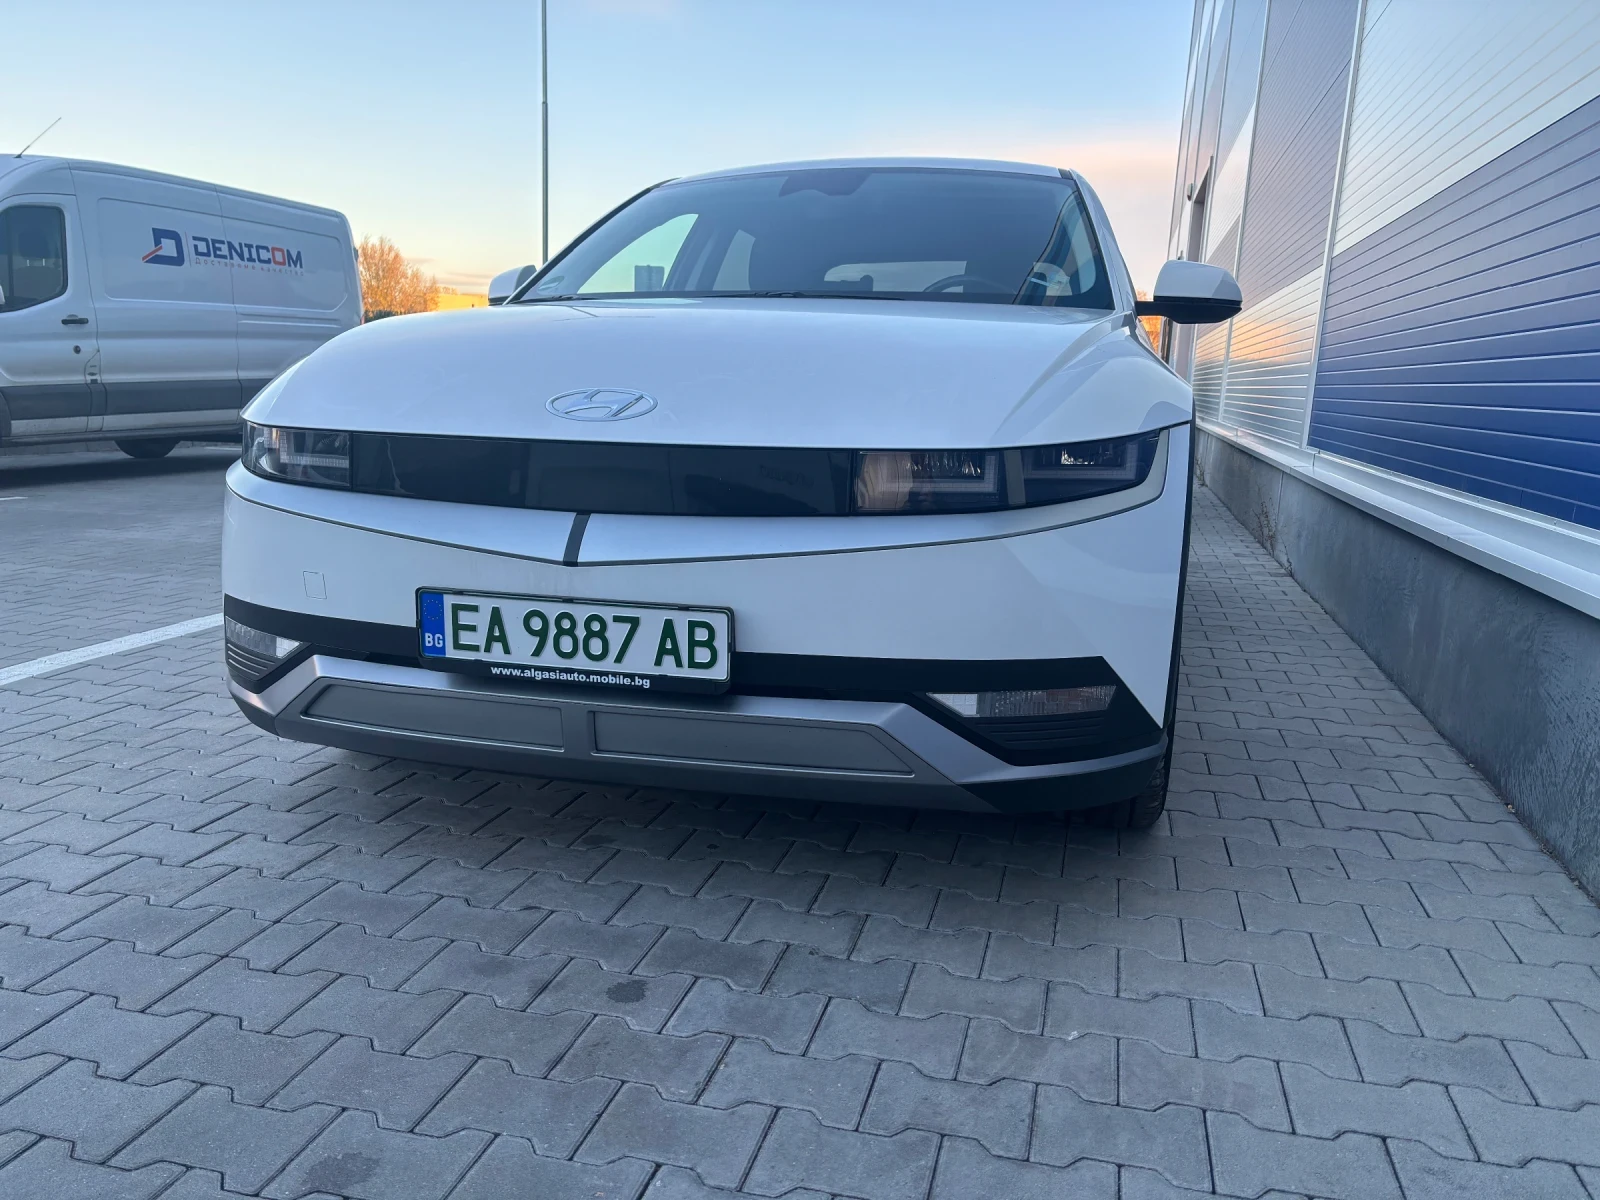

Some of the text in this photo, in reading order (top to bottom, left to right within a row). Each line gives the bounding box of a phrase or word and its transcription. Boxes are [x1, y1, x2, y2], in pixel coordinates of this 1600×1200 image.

[192, 236, 303, 269] DENICOM
[425, 632, 443, 648] BG
[451, 602, 718, 669] EA 9887 AB
[490, 665, 651, 689] www.algasiauto.mobile.bg
